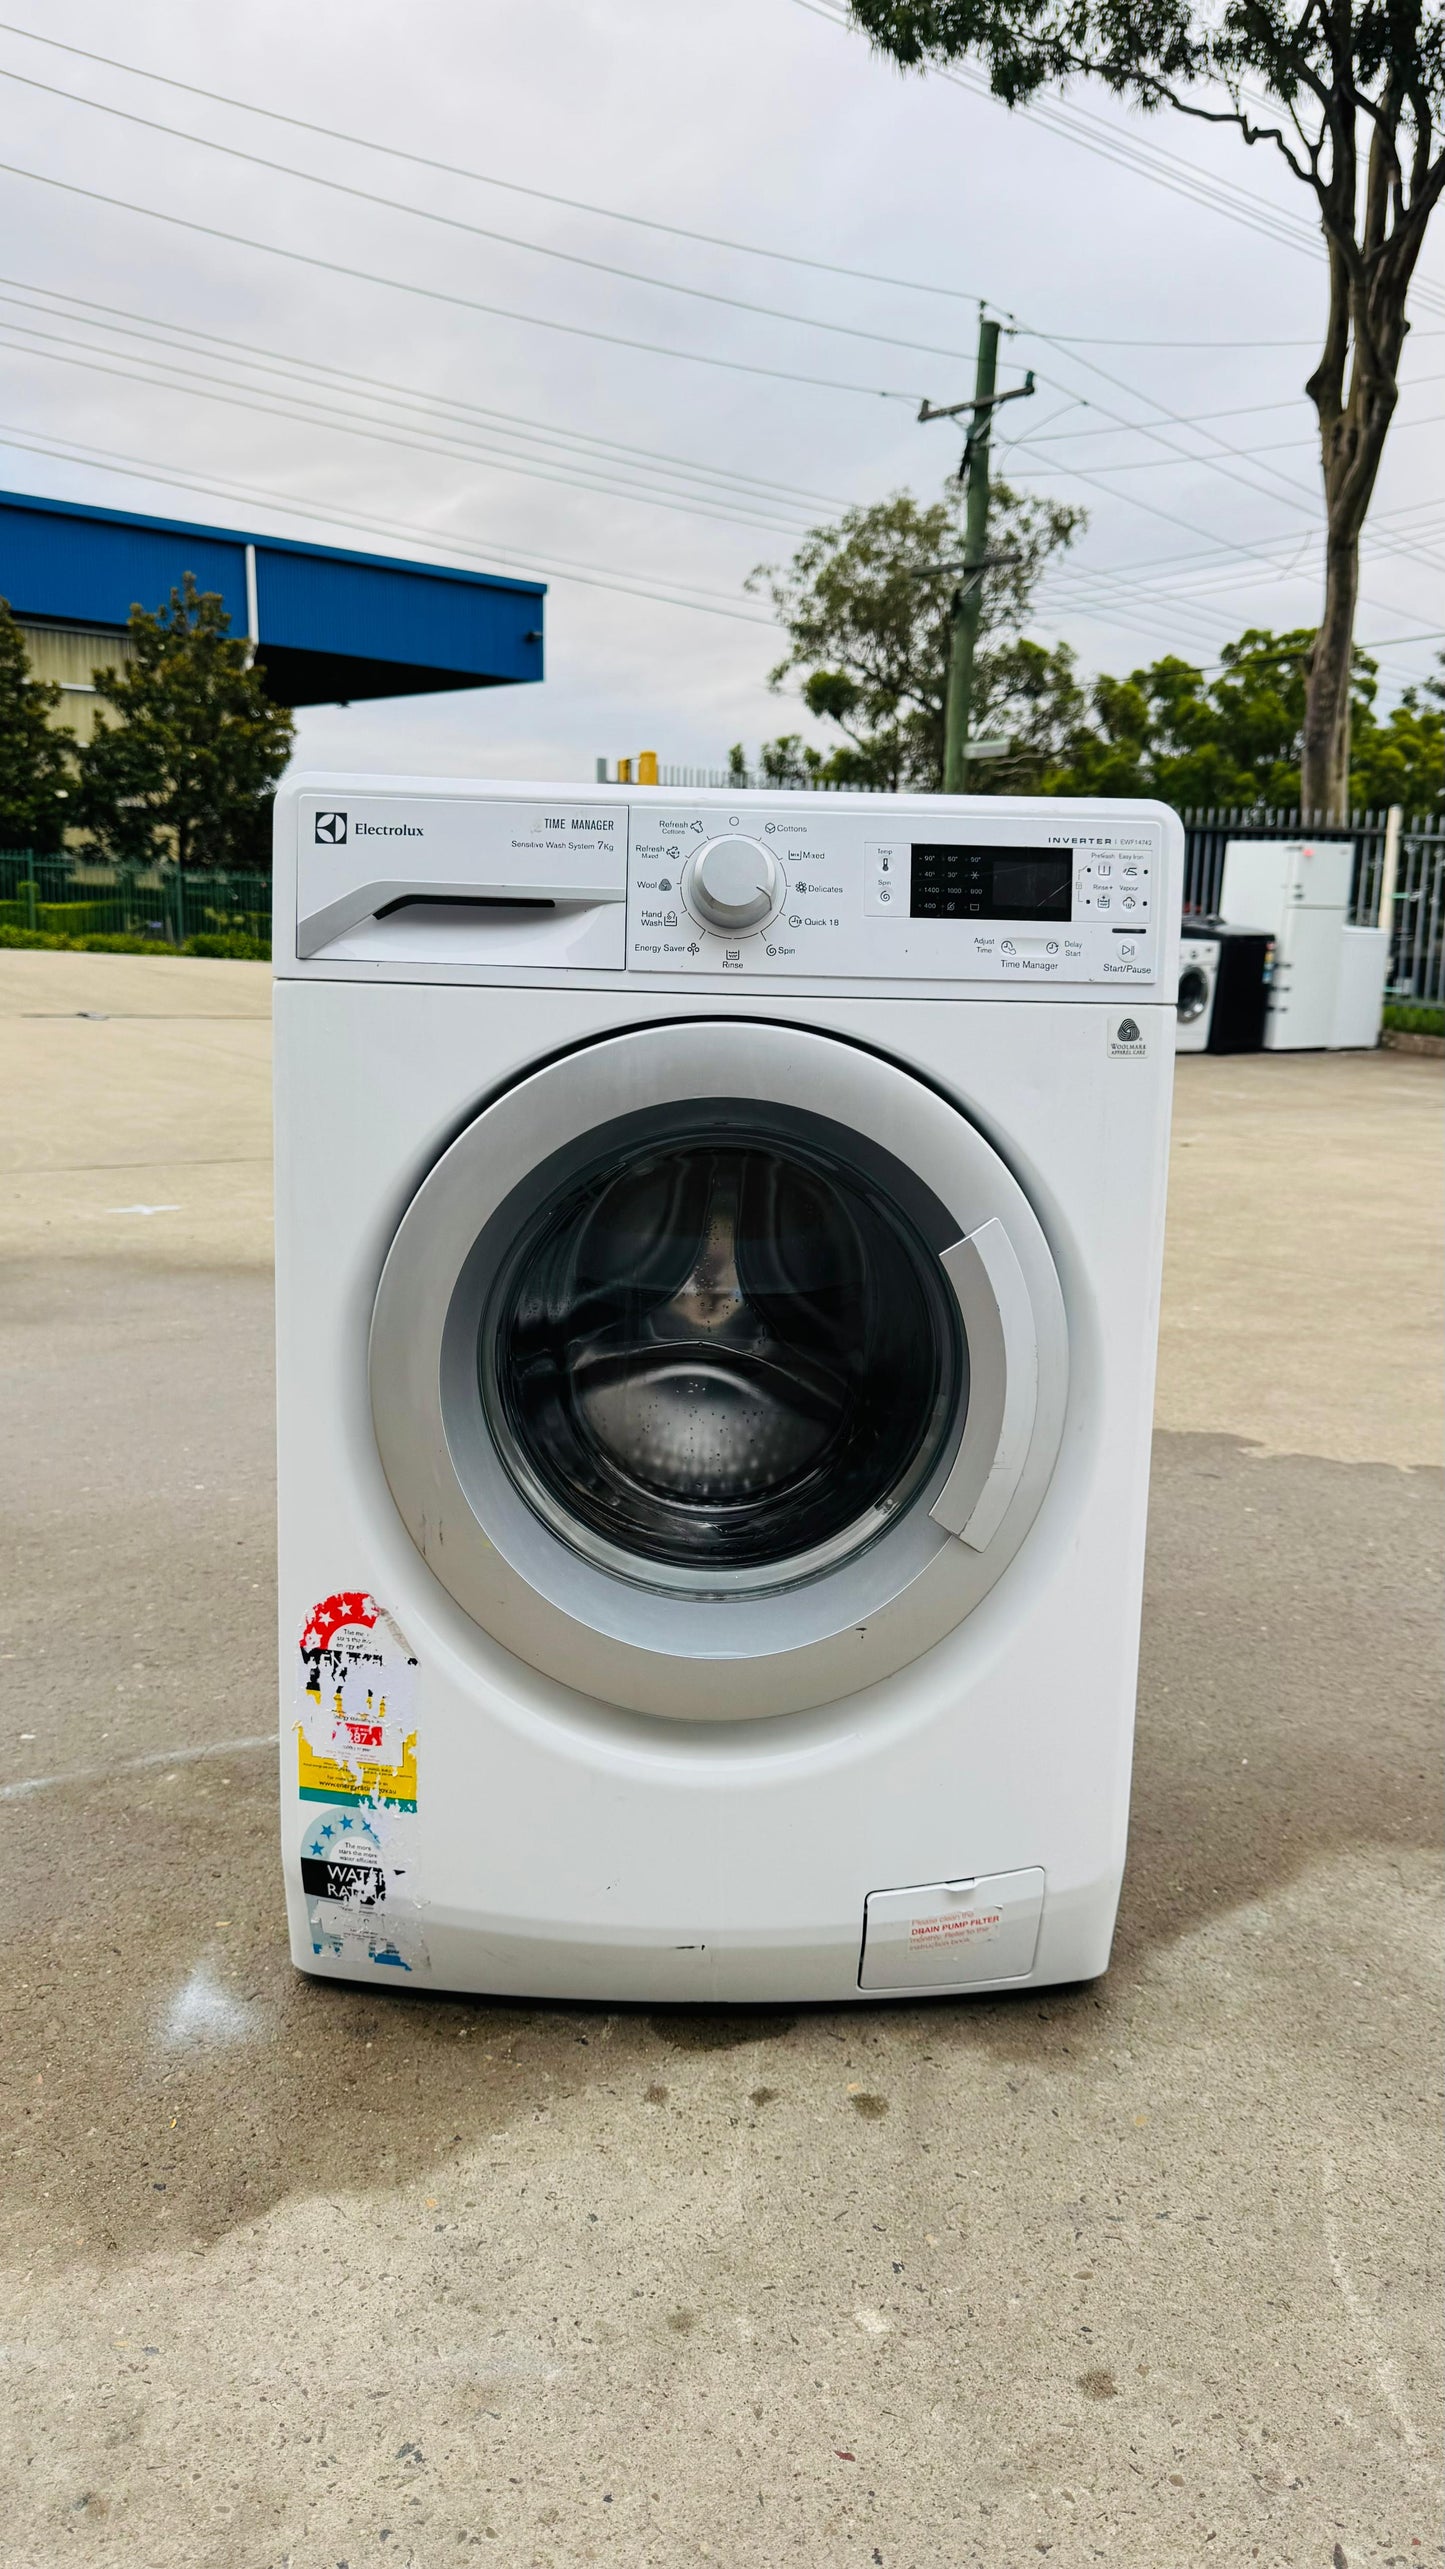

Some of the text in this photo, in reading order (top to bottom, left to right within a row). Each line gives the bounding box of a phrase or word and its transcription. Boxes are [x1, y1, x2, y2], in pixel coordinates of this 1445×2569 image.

[544, 818, 615, 831] TIME MANAGER
[659, 820, 689, 829] Refresh
[777, 824, 808, 832] Cottons
[355, 823, 424, 836] Electrolux
[511, 840, 544, 848] Sensitive
[546, 841, 566, 849] Wash
[568, 842, 595, 851] System
[1048, 837, 1112, 845] INVERTER
[635, 844, 665, 853] Refresh
[802, 851, 825, 859] Mixed
[808, 884, 843, 893] Delicates
[641, 910, 662, 918] Hand
[640, 919, 663, 927] Wash
[804, 917, 827, 926] Quick
[829, 918, 839, 926] 18
[974, 937, 995, 946] Adjust
[1064, 940, 1082, 948] Delay
[634, 943, 686, 953] Energy Saver
[778, 946, 796, 955] Spin
[977, 946, 992, 954] Time
[1065, 949, 1081, 957] Start
[722, 960, 744, 969] Rinse
[1001, 959, 1058, 971] Time Manager
[1103, 963, 1152, 975] Start/Pause
[911, 1915, 1000, 1936] DRAIN PUMP FILTER
